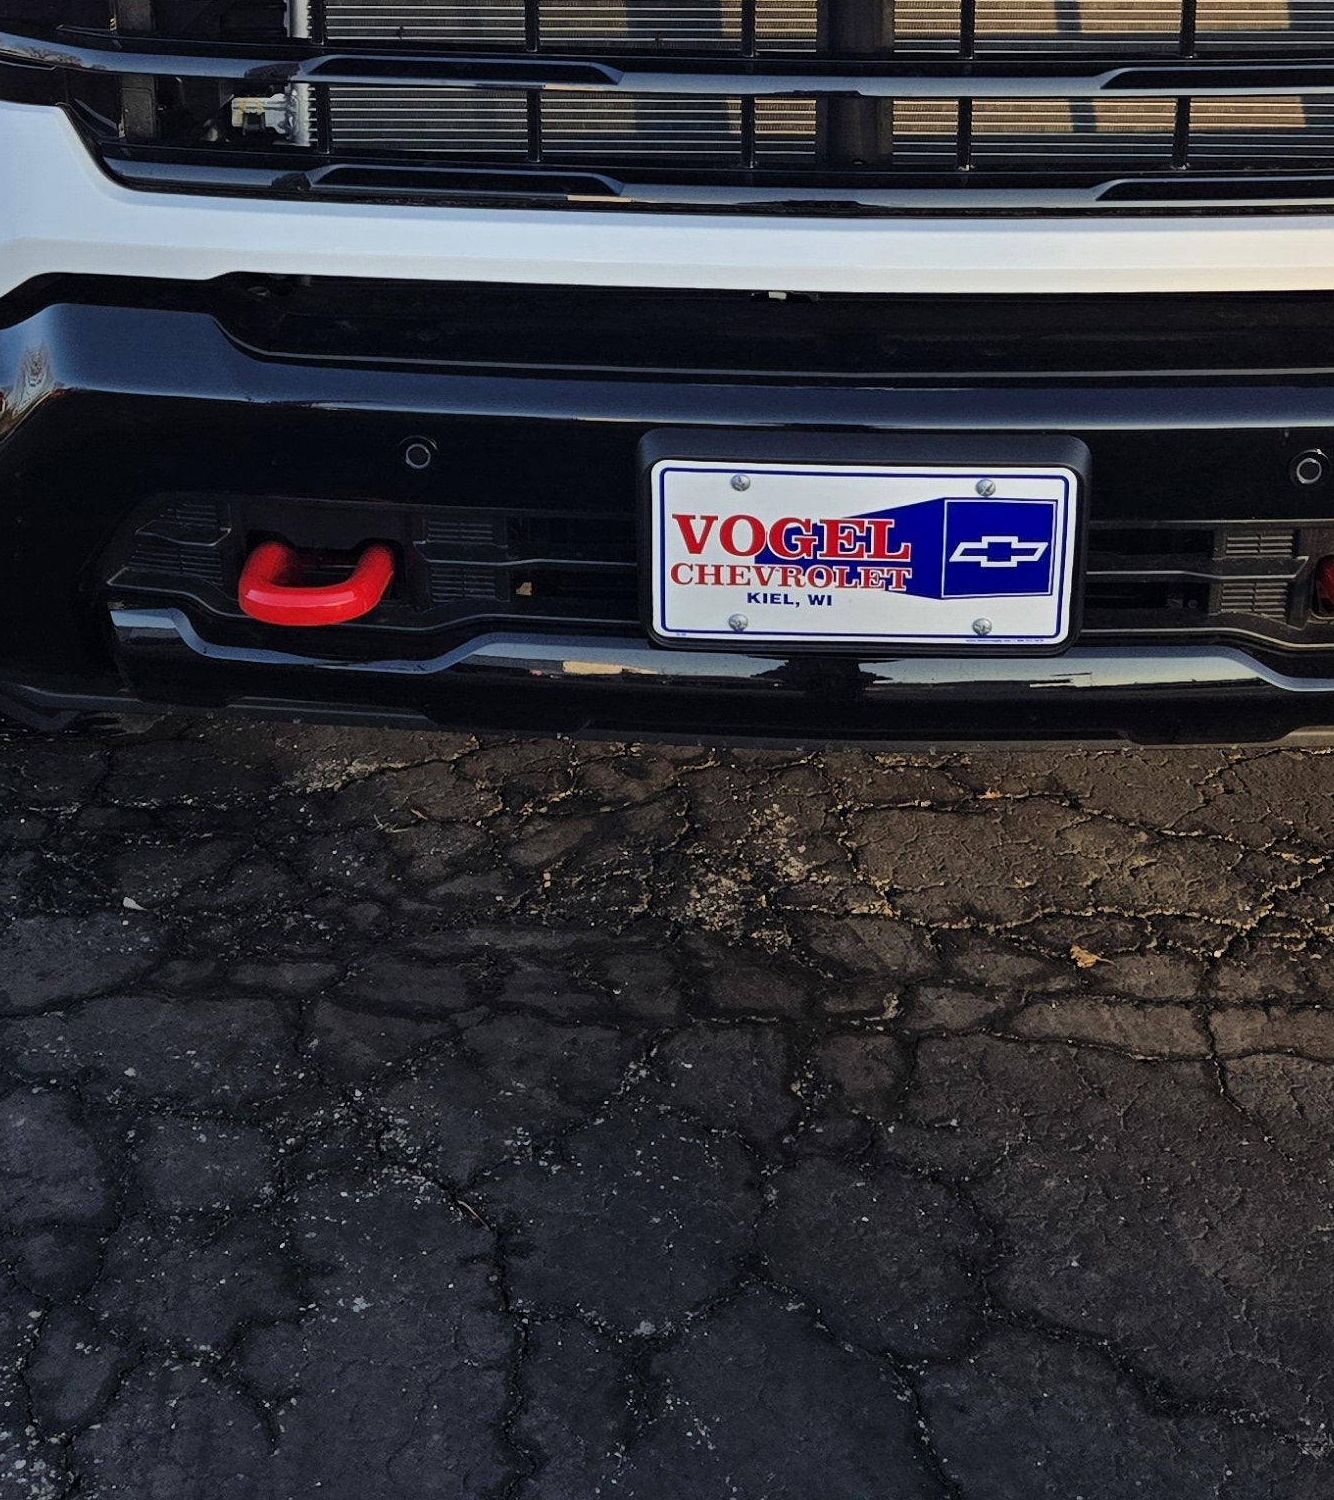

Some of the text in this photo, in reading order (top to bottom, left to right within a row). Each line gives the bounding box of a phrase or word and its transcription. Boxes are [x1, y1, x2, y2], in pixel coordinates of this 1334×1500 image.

[671, 513, 911, 561] VOGEL
[670, 562, 911, 591] CHEVROLET
[747, 592, 833, 608] KIEL, WI
